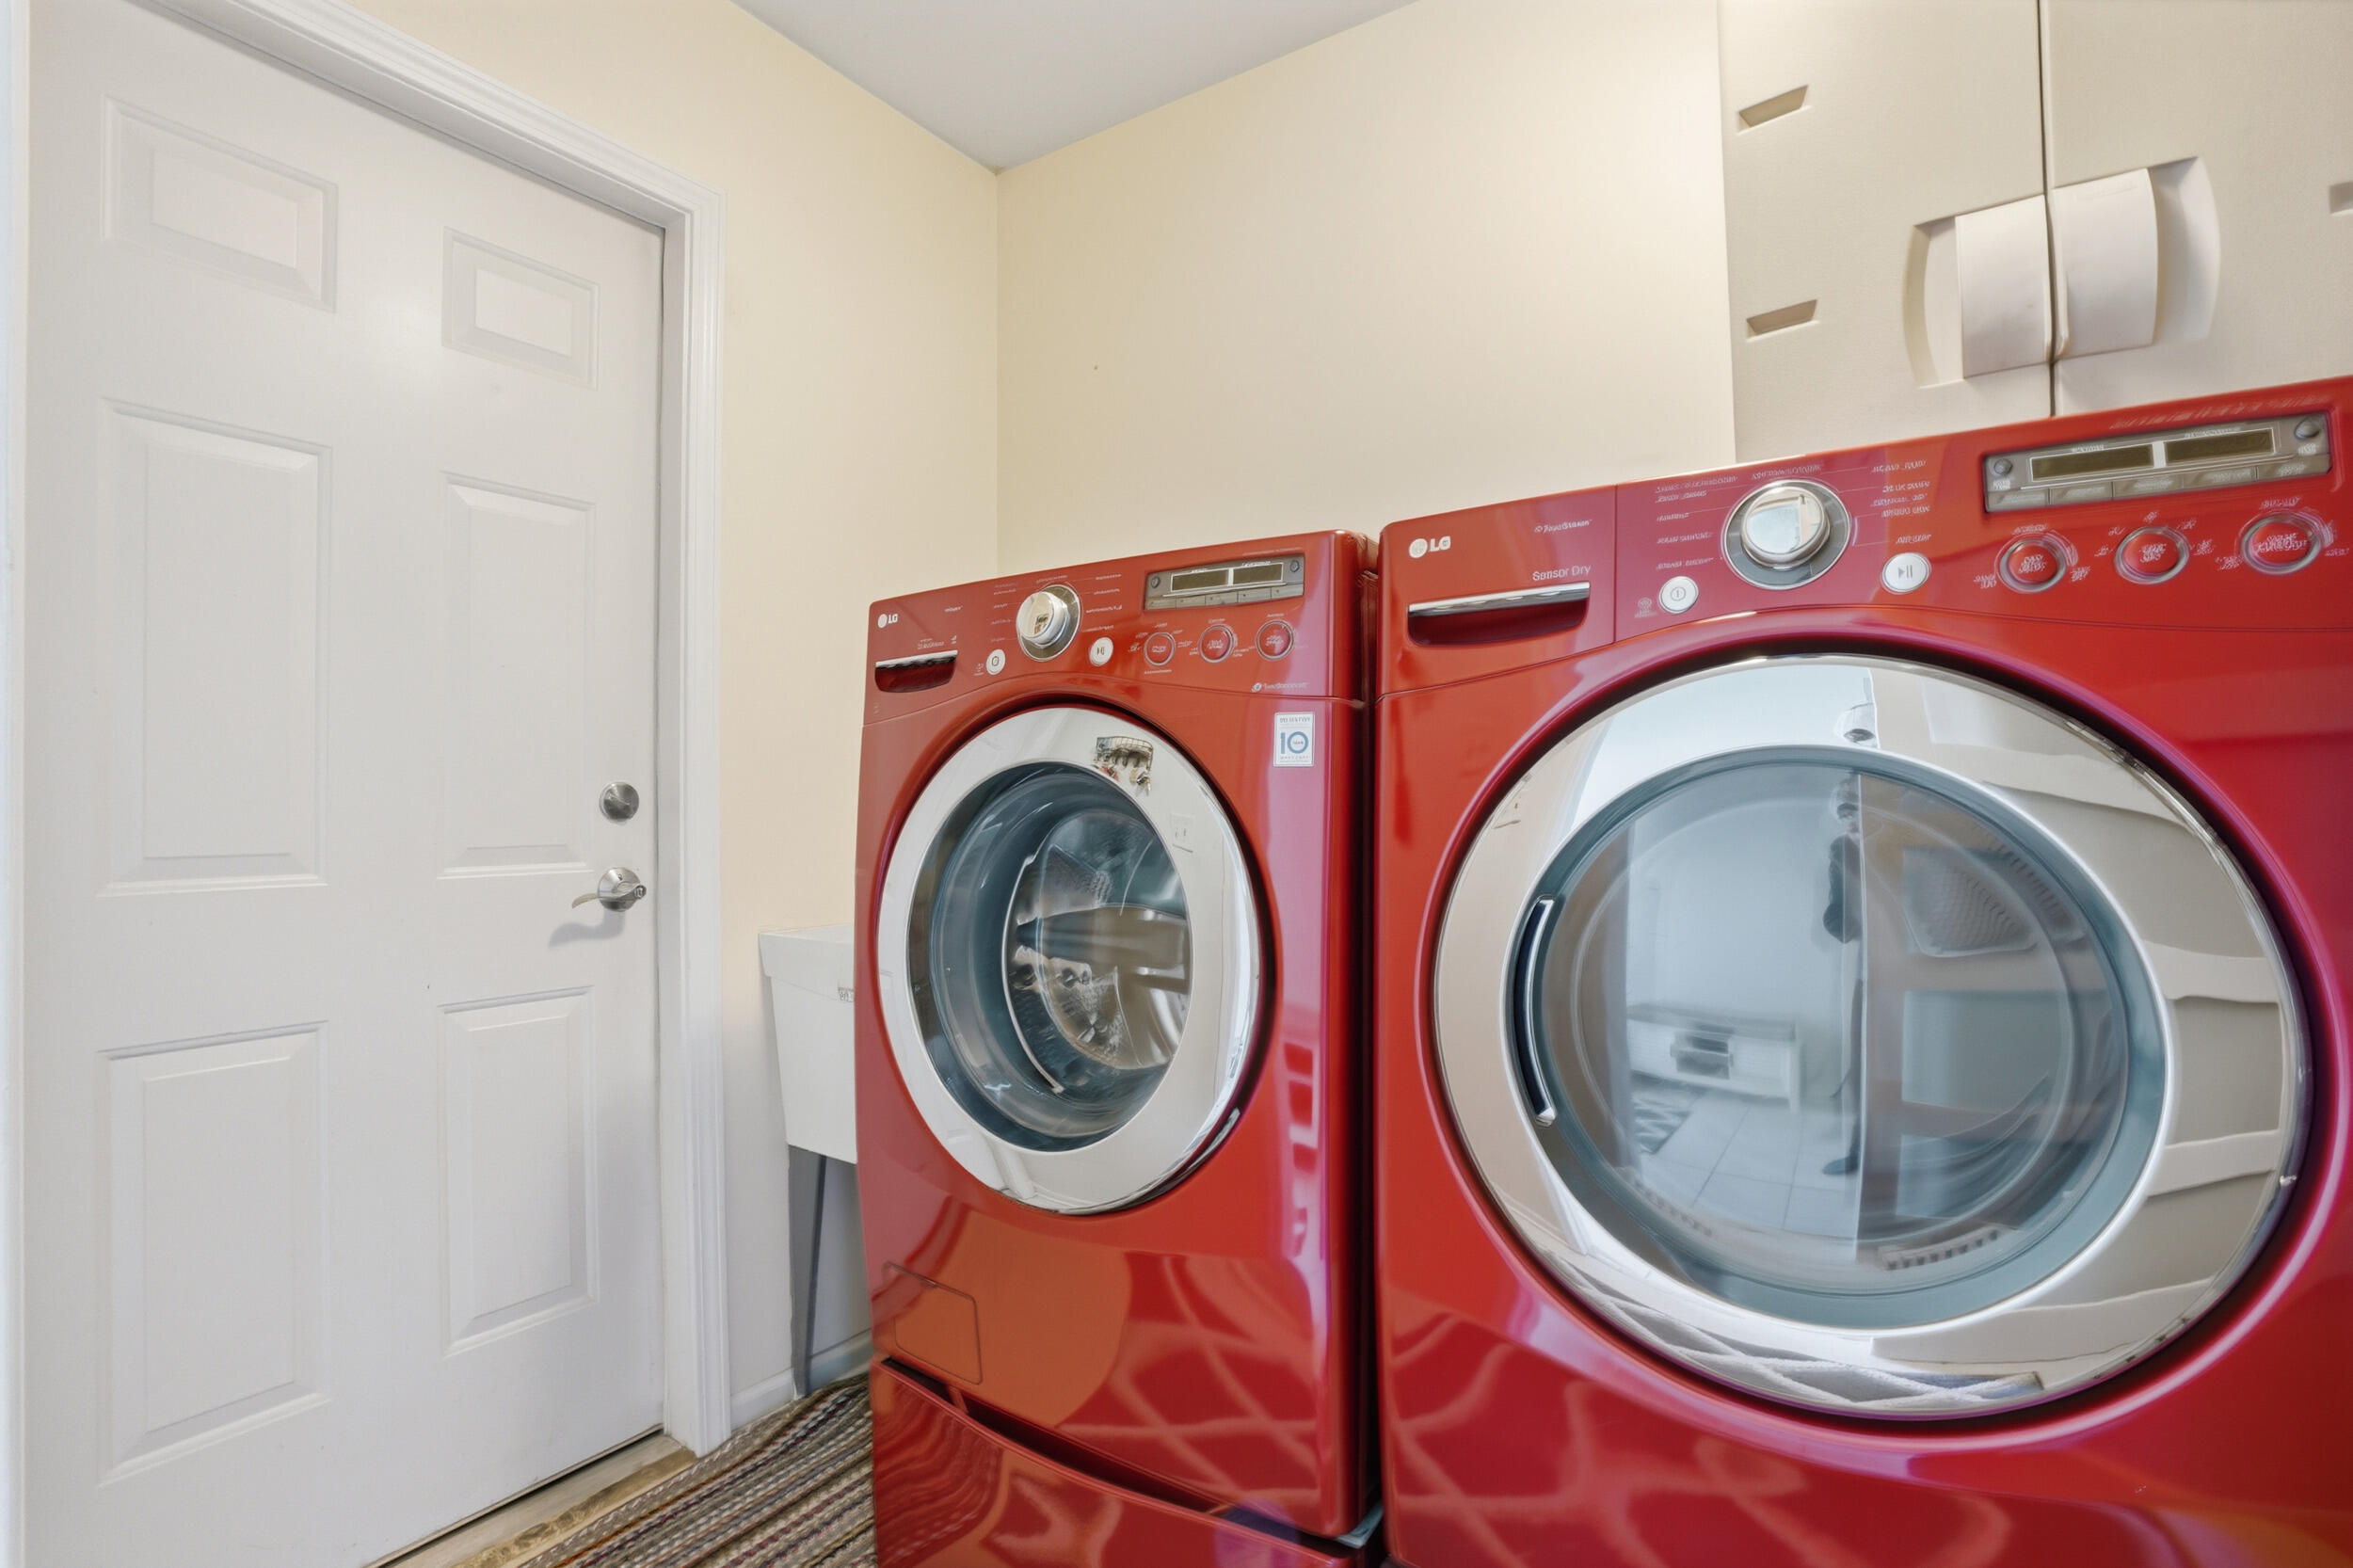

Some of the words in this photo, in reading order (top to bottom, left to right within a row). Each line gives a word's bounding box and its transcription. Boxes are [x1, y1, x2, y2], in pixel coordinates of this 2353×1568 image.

[1429, 536, 1451, 552] LG
[1532, 568, 1569, 581] Sensor
[1571, 565, 1592, 578] Dry
[1280, 731, 1309, 754] 10
